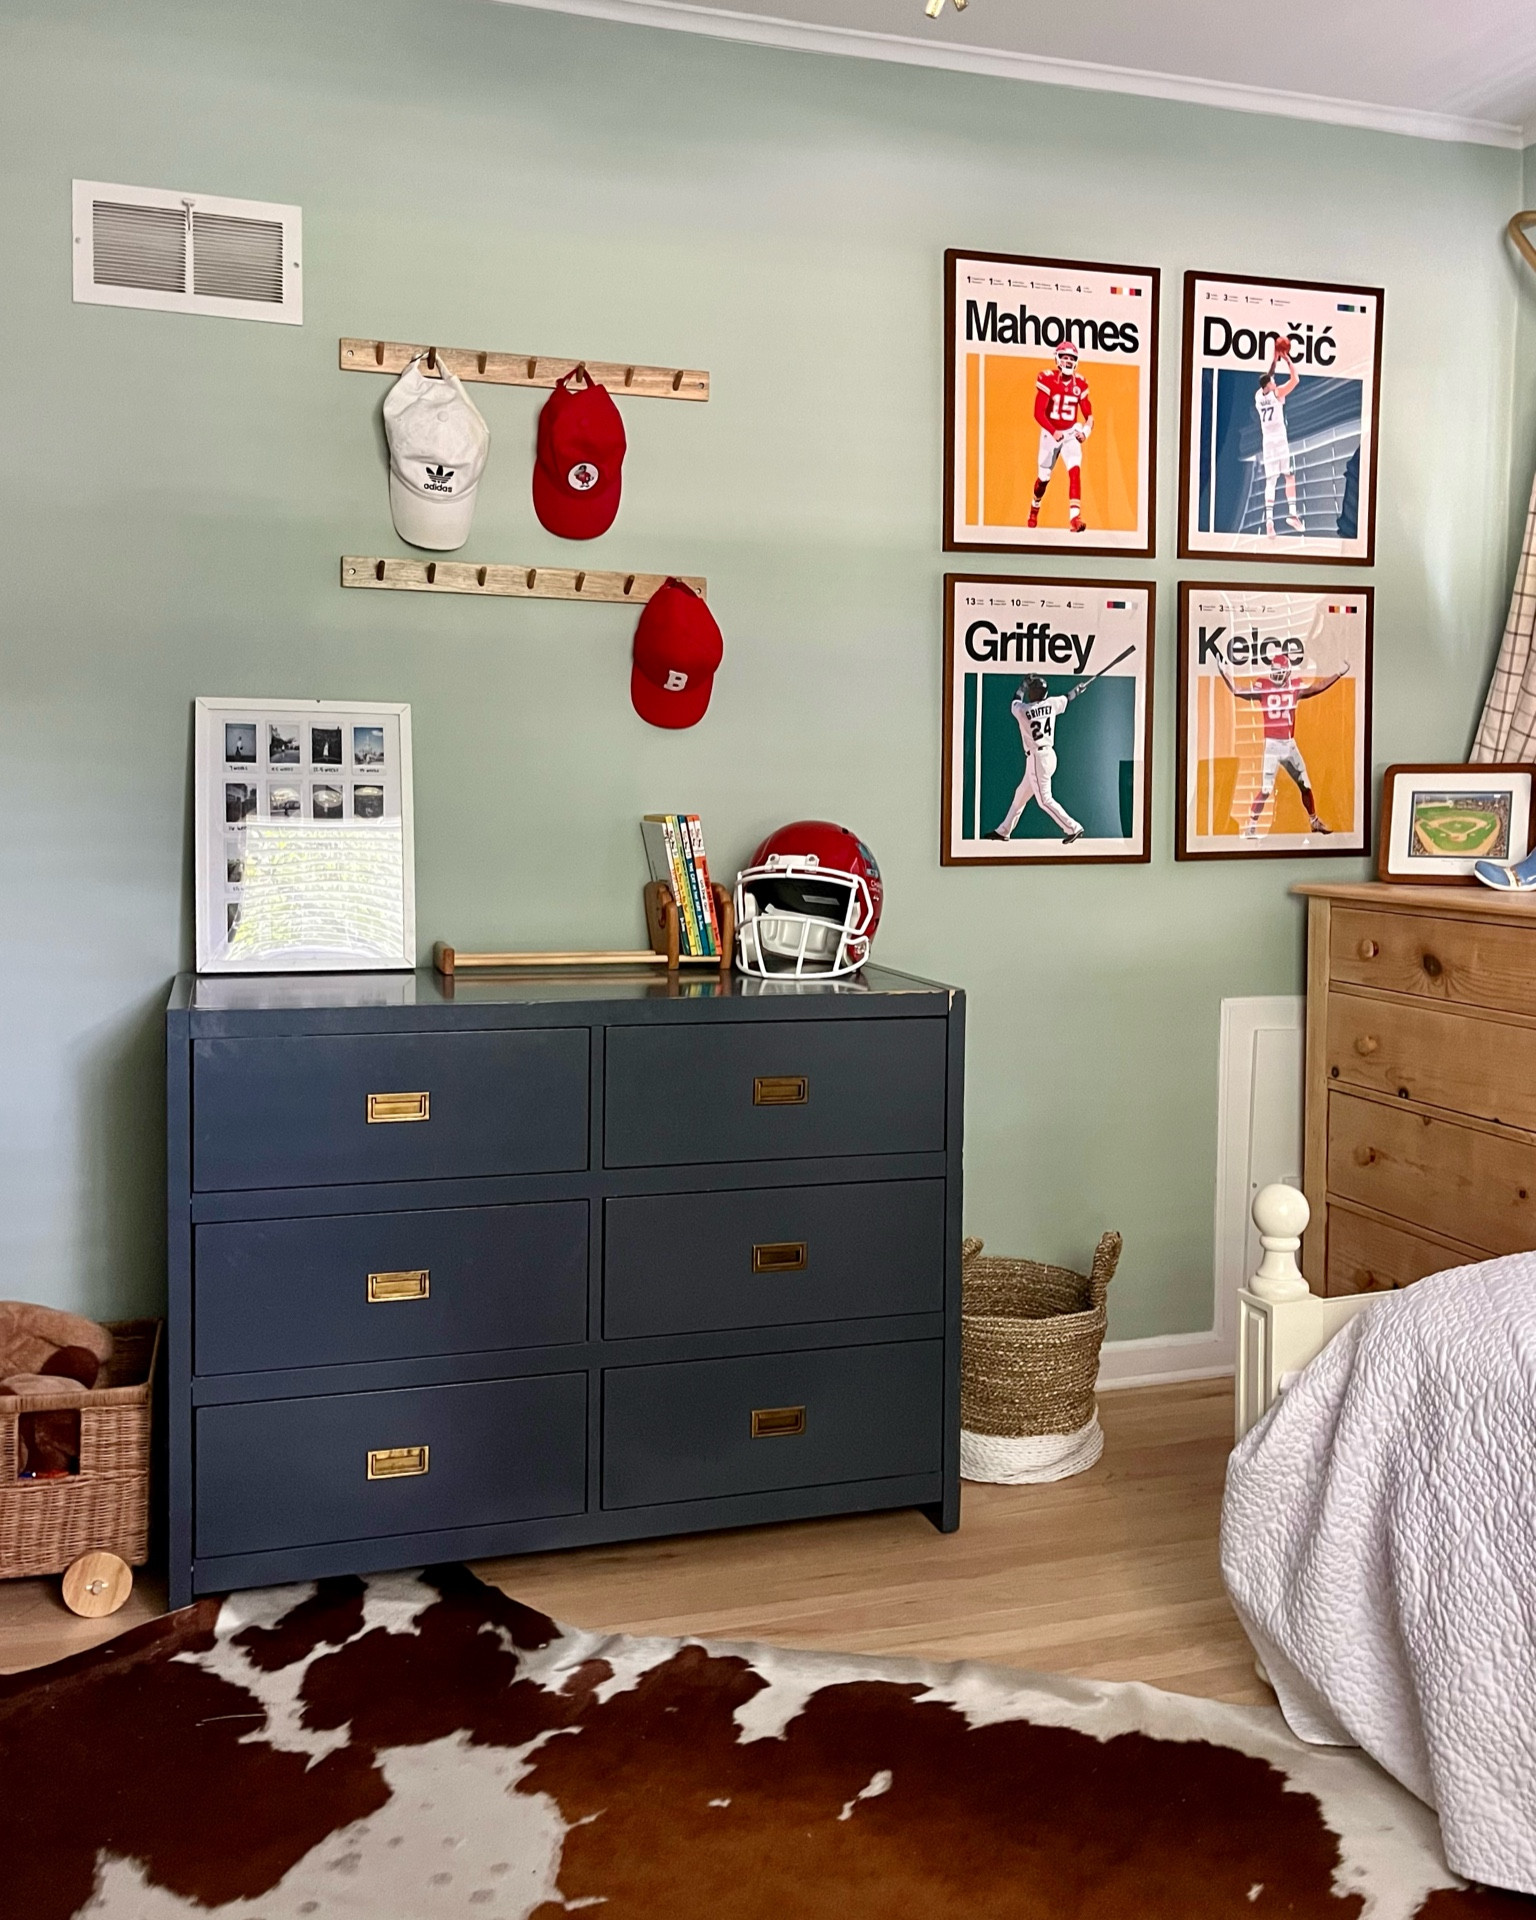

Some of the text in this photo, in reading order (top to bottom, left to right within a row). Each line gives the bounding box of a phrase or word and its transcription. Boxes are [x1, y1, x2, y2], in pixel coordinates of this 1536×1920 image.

[966, 299, 1139, 353] Mahomes
[1203, 316, 1336, 366] Dončić
[1050, 394, 1078, 421] 15
[1261, 406, 1274, 422] 77
[424, 483, 453, 493] adidas
[965, 620, 1095, 674] Griffey
[1198, 626, 1304, 666] Kelce
[664, 669, 688, 691] B
[1025, 705, 1052, 720] GRIFFEY
[1267, 694, 1294, 719] 87
[1030, 716, 1052, 741] 24
